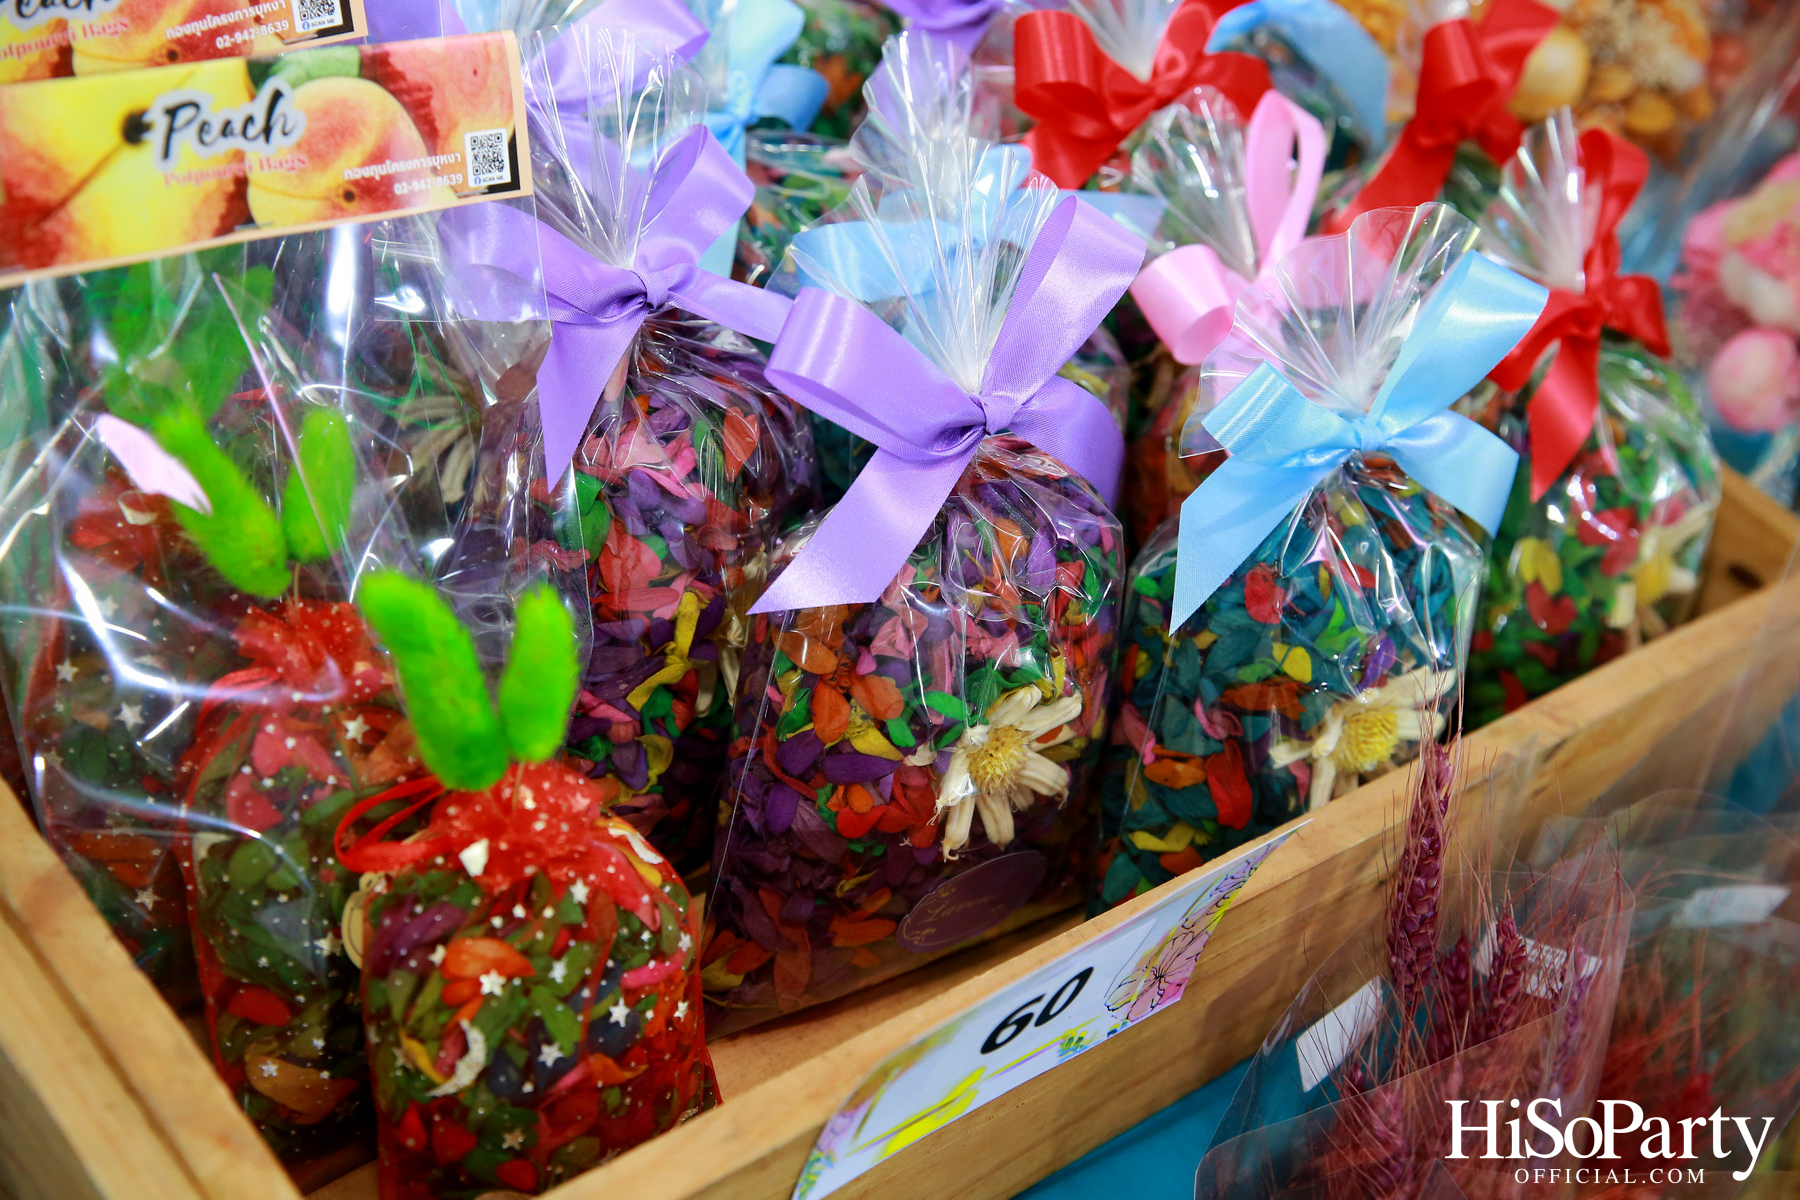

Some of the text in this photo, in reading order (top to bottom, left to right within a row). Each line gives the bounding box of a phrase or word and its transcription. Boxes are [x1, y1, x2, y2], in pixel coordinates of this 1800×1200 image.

[81, 18, 129, 39] Bags
[215, 19, 290, 49] 02-942-8639
[310, 19, 326, 28] SCAN
[162, 88, 298, 161] Peach
[259, 154, 308, 173] Bags
[393, 172, 463, 196] 02-942-8639
[980, 966, 1094, 1055] 60
